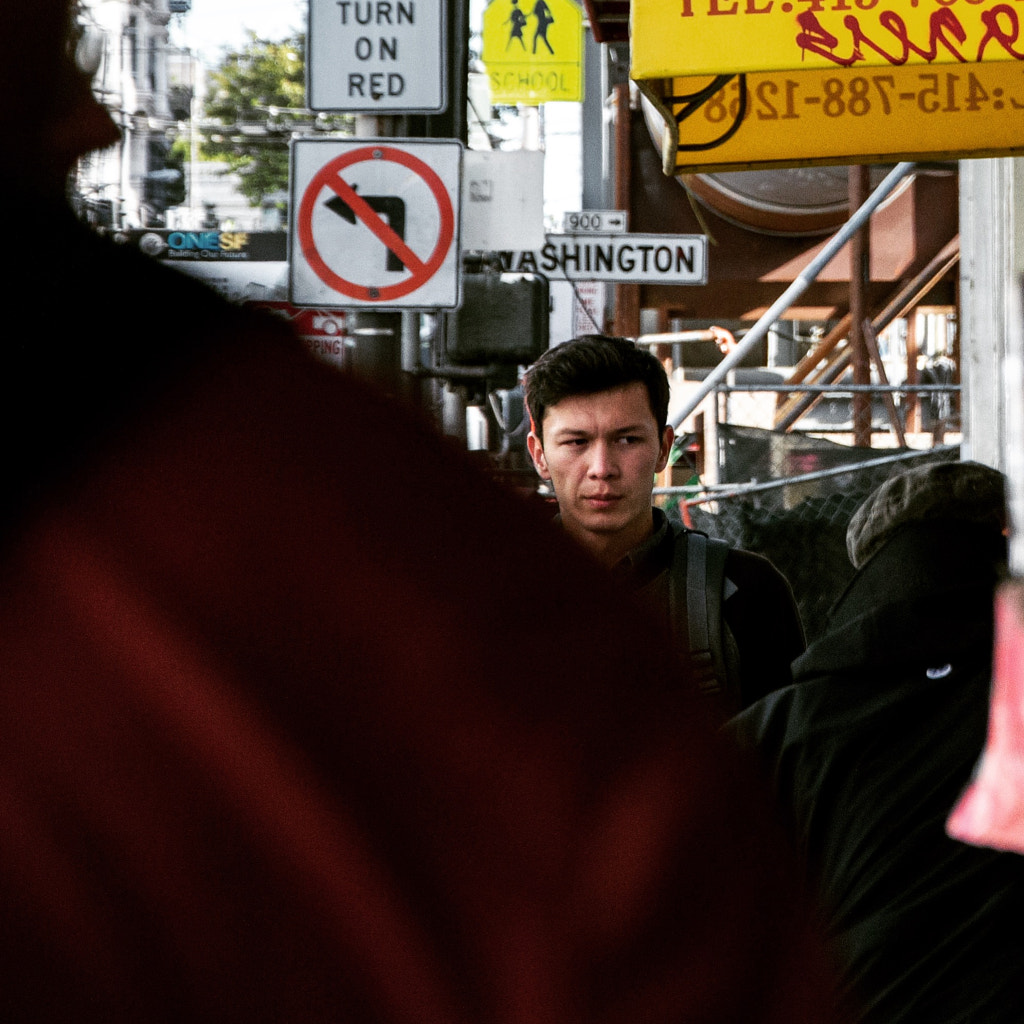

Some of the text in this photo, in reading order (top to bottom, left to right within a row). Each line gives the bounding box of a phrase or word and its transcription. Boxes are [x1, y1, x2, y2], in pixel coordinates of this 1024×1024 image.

[336, 1, 416, 25] TURN
[355, 37, 398, 60] ON
[349, 73, 405, 97] RED
[490, 72, 569, 93] SCHOOL
[569, 215, 601, 230] 900
